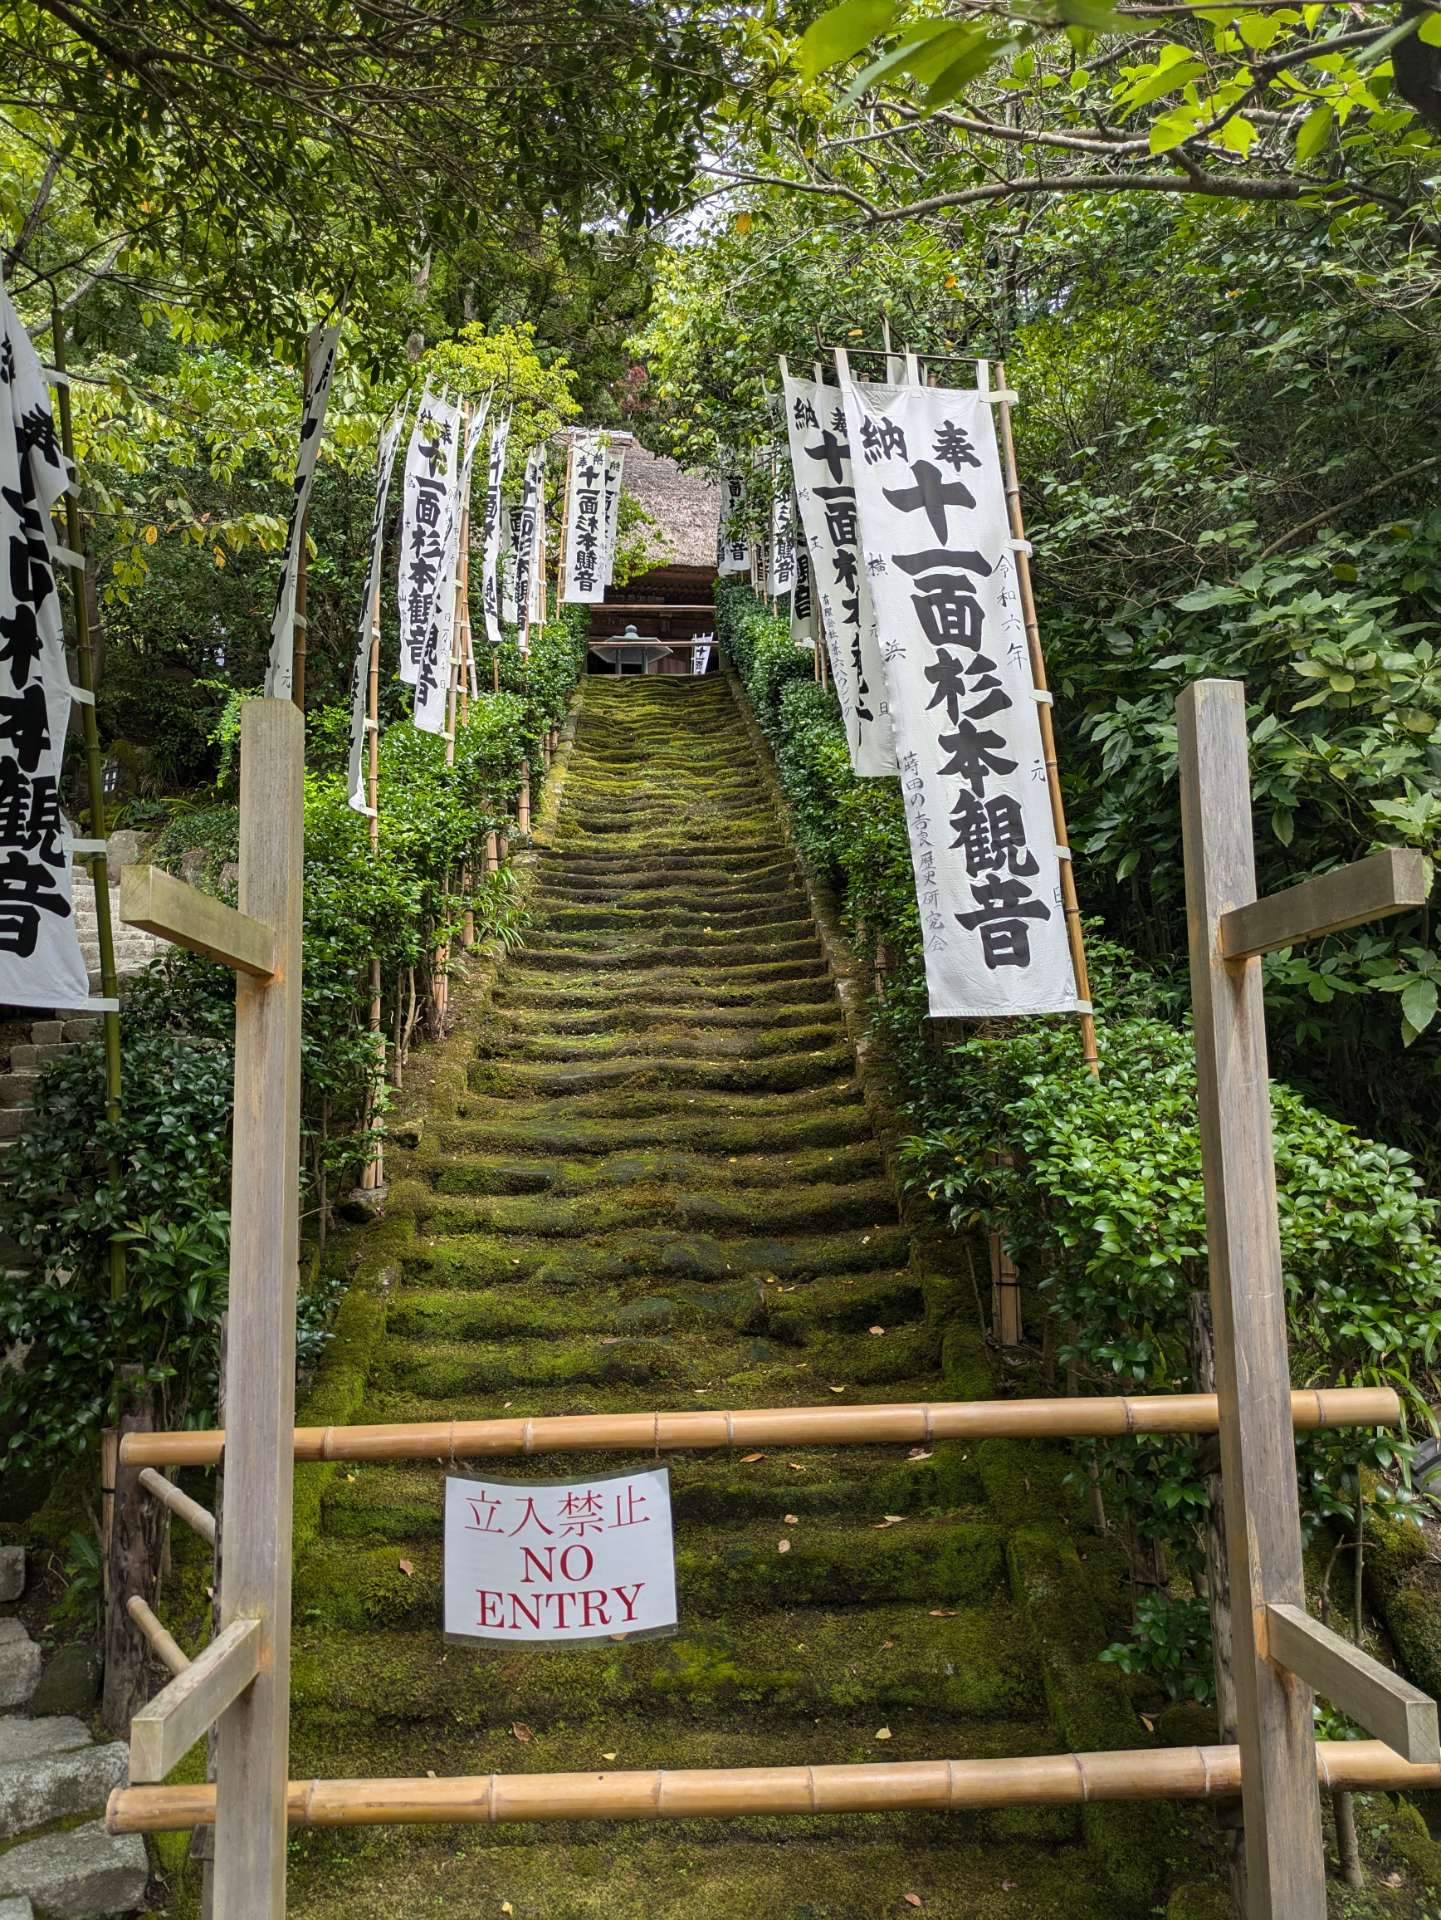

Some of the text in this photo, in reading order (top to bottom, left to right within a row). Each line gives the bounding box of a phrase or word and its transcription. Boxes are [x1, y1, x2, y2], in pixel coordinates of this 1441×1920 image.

[860, 414, 983, 473] 奉納
[866, 551, 907, 662] 横浜
[882, 459, 1052, 970] 十一面杉本観音
[464, 1484, 651, 1539] 立入禁止
[519, 1544, 594, 1583] NO
[476, 1582, 646, 1630] ENTRY
